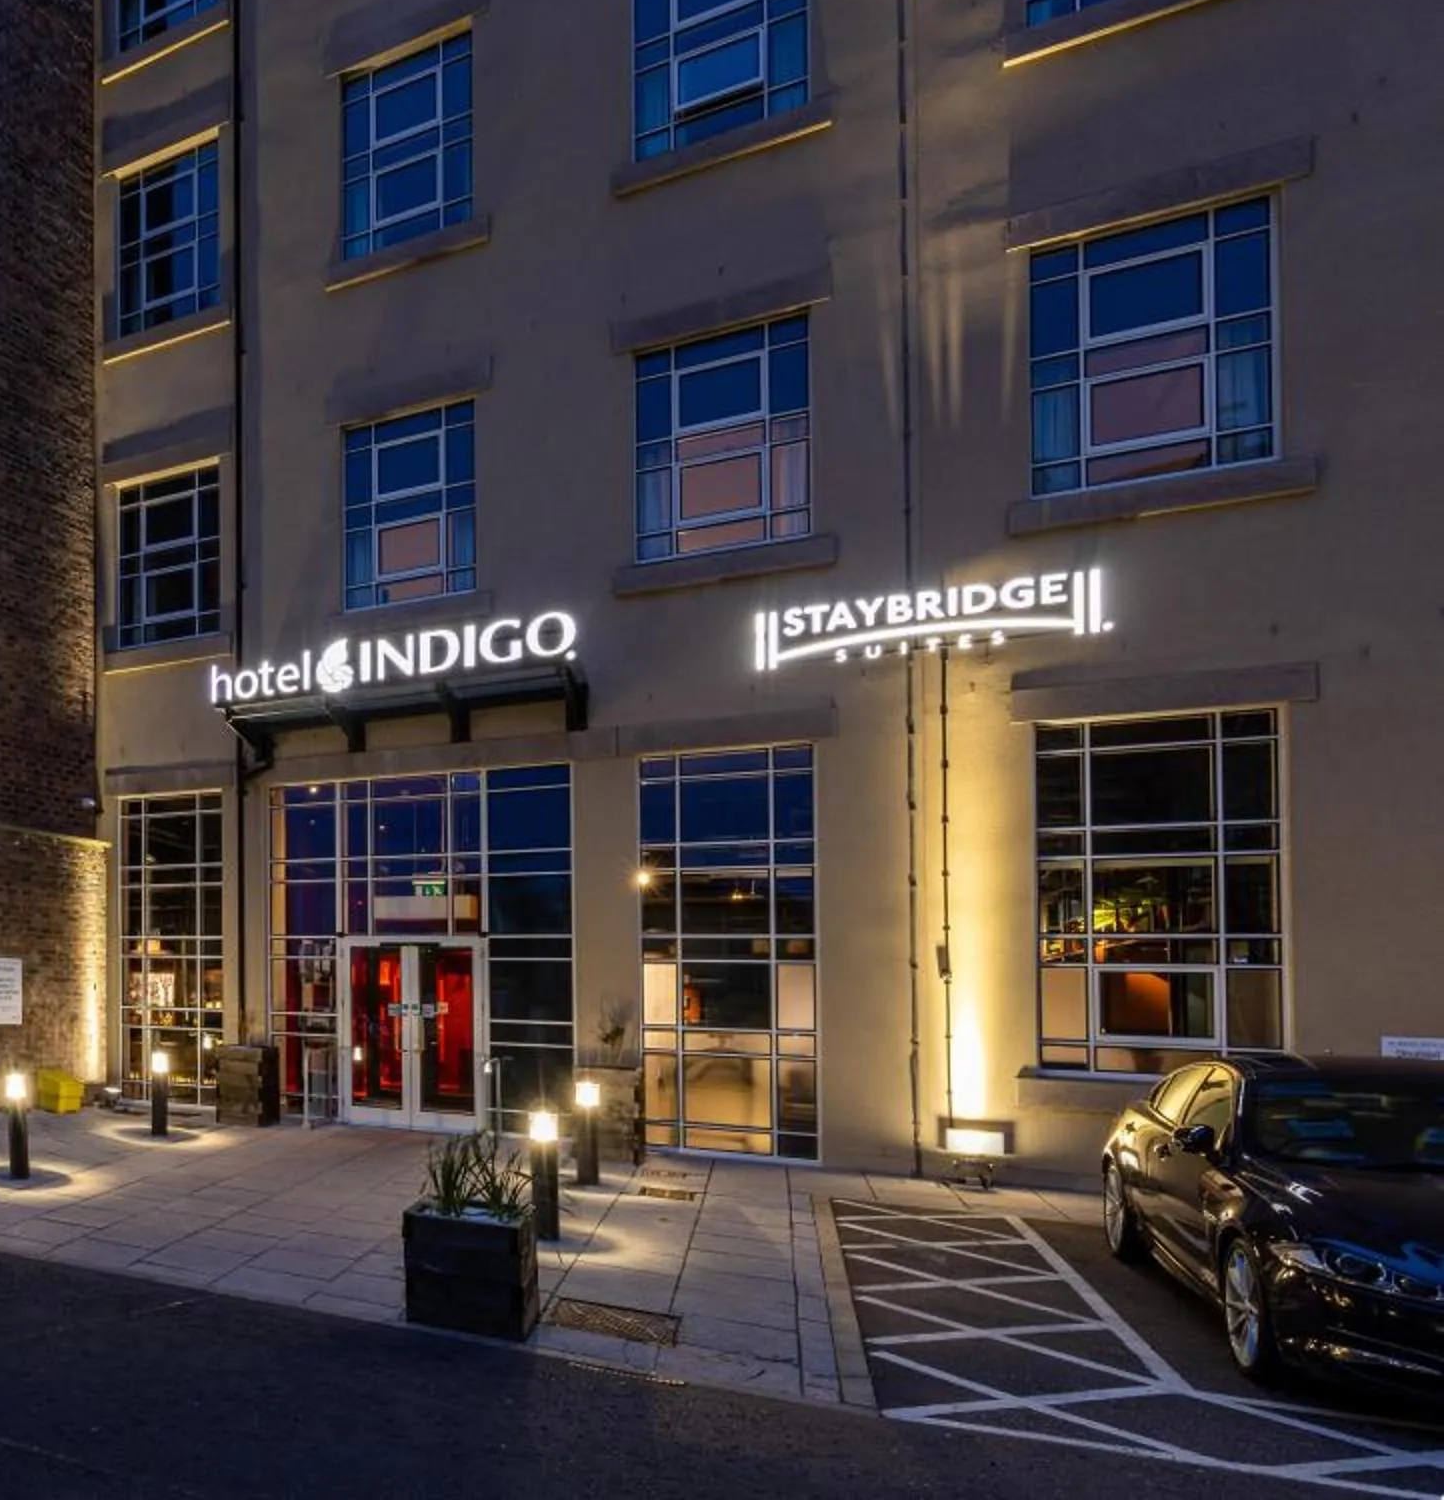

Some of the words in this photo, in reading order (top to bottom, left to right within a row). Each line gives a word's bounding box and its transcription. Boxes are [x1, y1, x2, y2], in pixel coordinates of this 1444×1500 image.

[782, 572, 1069, 638] STAYBRIDGE
[834, 629, 1007, 664] SUITES
[210, 649, 312, 704] hotel
